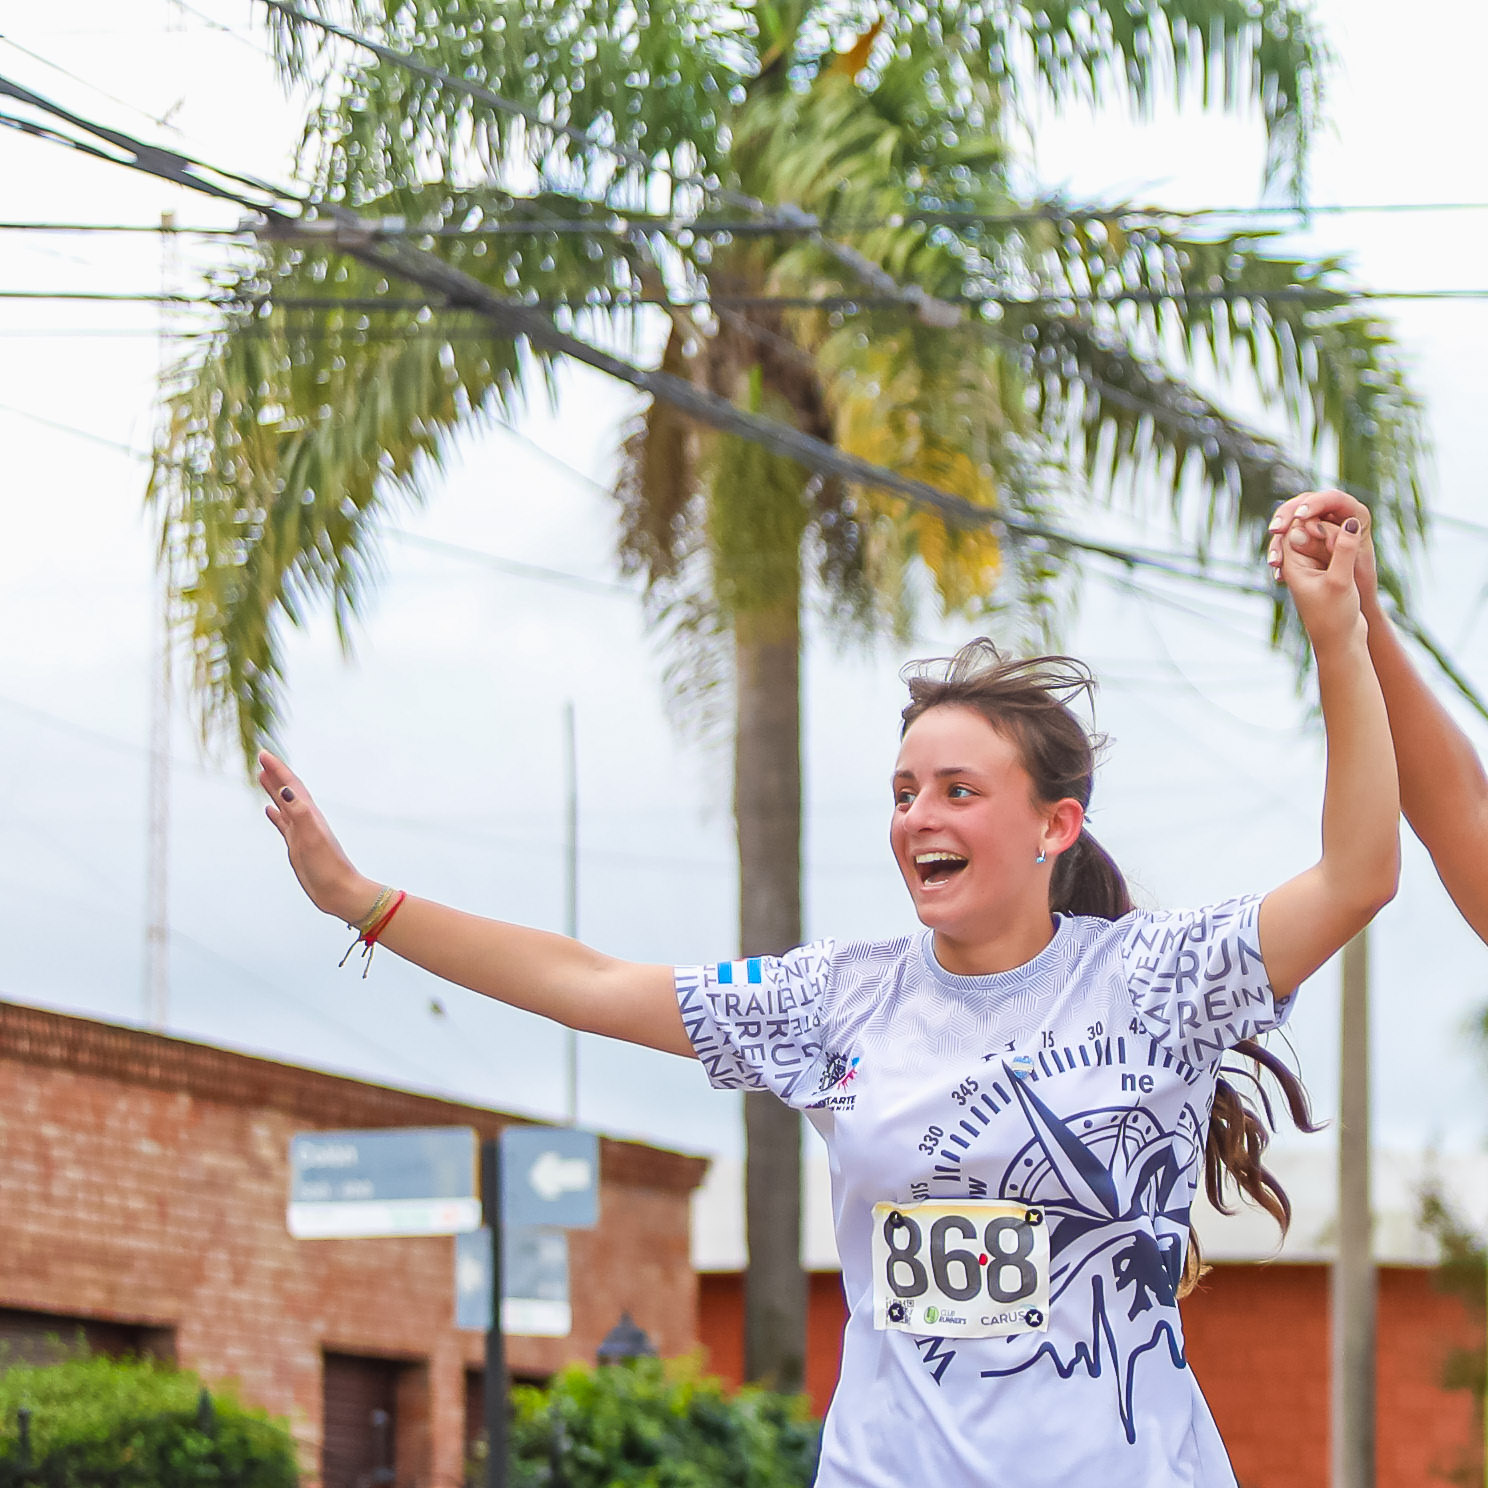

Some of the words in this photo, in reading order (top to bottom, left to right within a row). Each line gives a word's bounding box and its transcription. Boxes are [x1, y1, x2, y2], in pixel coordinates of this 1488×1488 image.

[1041, 1031, 1054, 1048] 15
[1087, 1021, 1103, 1040] 30
[951, 1075, 980, 1106] 345
[1121, 1073, 1155, 1093] ne
[918, 1125, 944, 1156] 330
[883, 1214, 1038, 1304] 868
[980, 1310, 1027, 1327] CARUS
